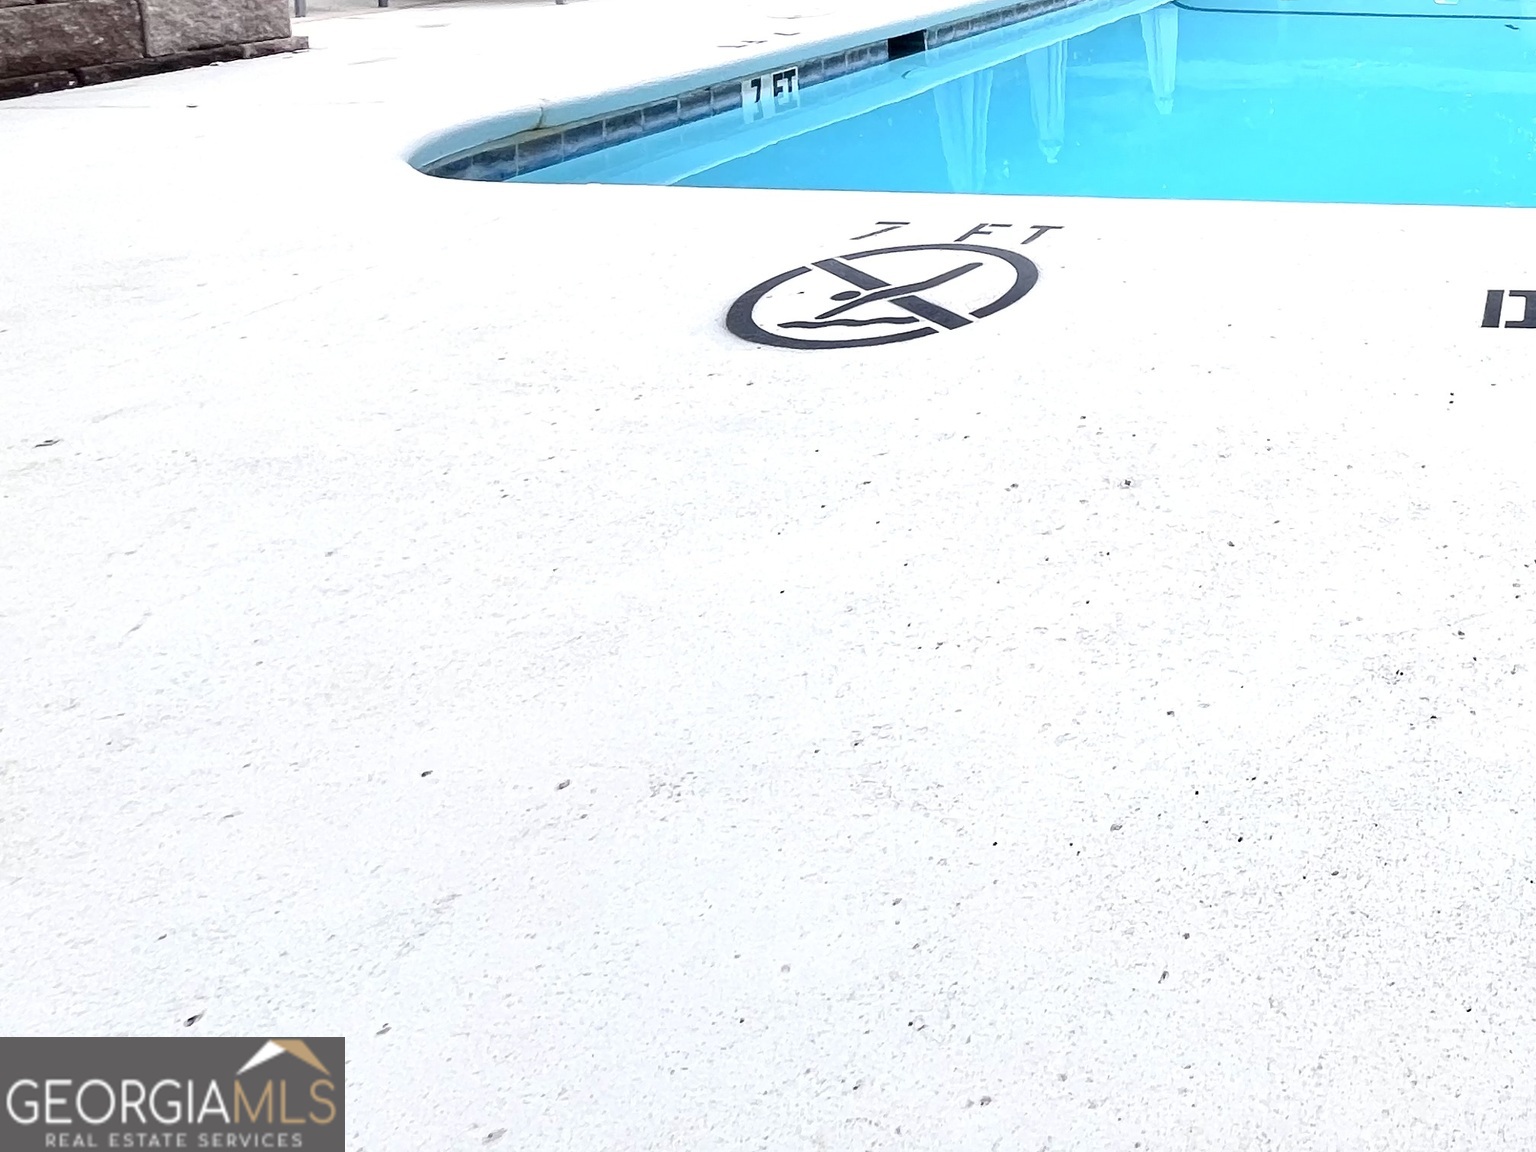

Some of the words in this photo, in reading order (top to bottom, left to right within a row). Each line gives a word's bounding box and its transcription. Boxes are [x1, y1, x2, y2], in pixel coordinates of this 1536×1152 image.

[750, 77, 762, 104] 7
[772, 68, 797, 98] FT
[849, 220, 911, 241] 7
[953, 222, 1066, 245] FT
